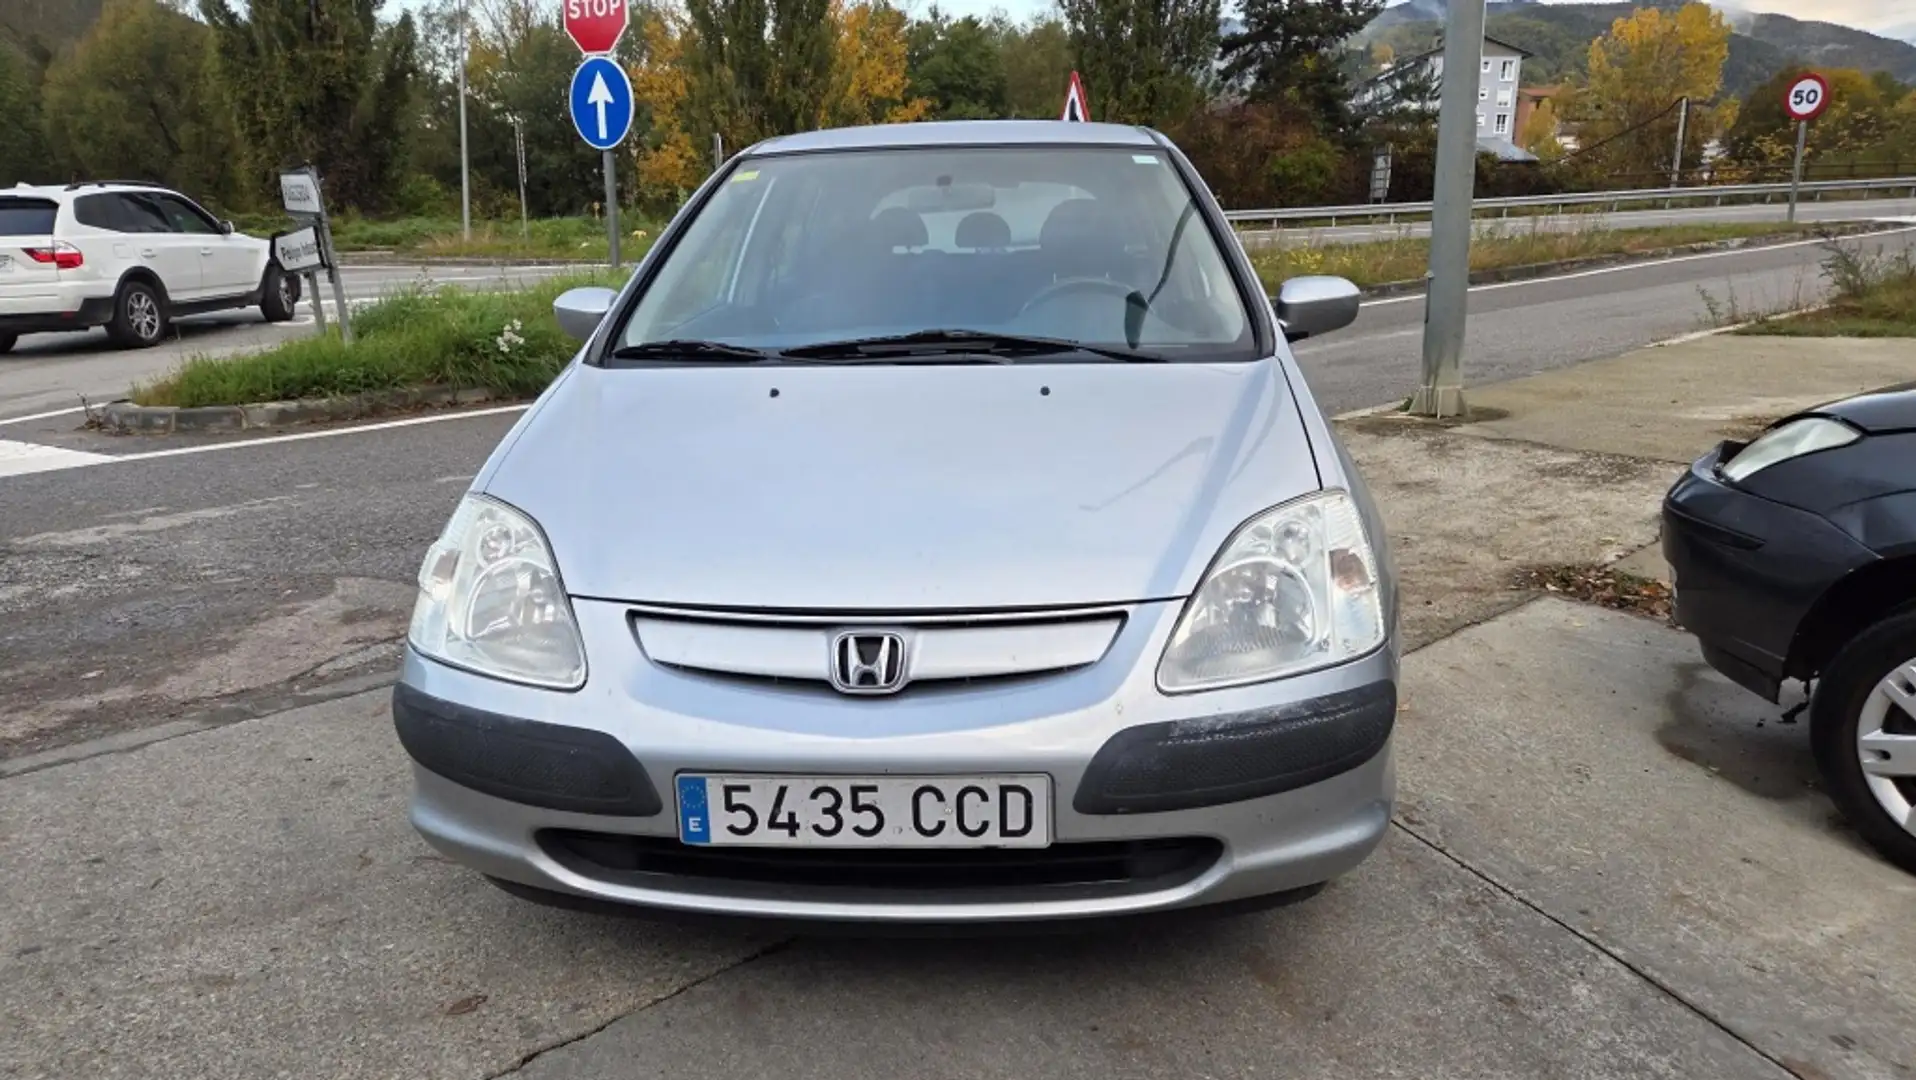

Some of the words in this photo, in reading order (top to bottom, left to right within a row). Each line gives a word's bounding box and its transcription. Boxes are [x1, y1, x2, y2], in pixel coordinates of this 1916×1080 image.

[568, 0, 621, 19] STOP
[1792, 88, 1818, 106] 50
[722, 784, 885, 838] 5435
[911, 784, 1034, 838] CCD
[688, 816, 703, 832] E
